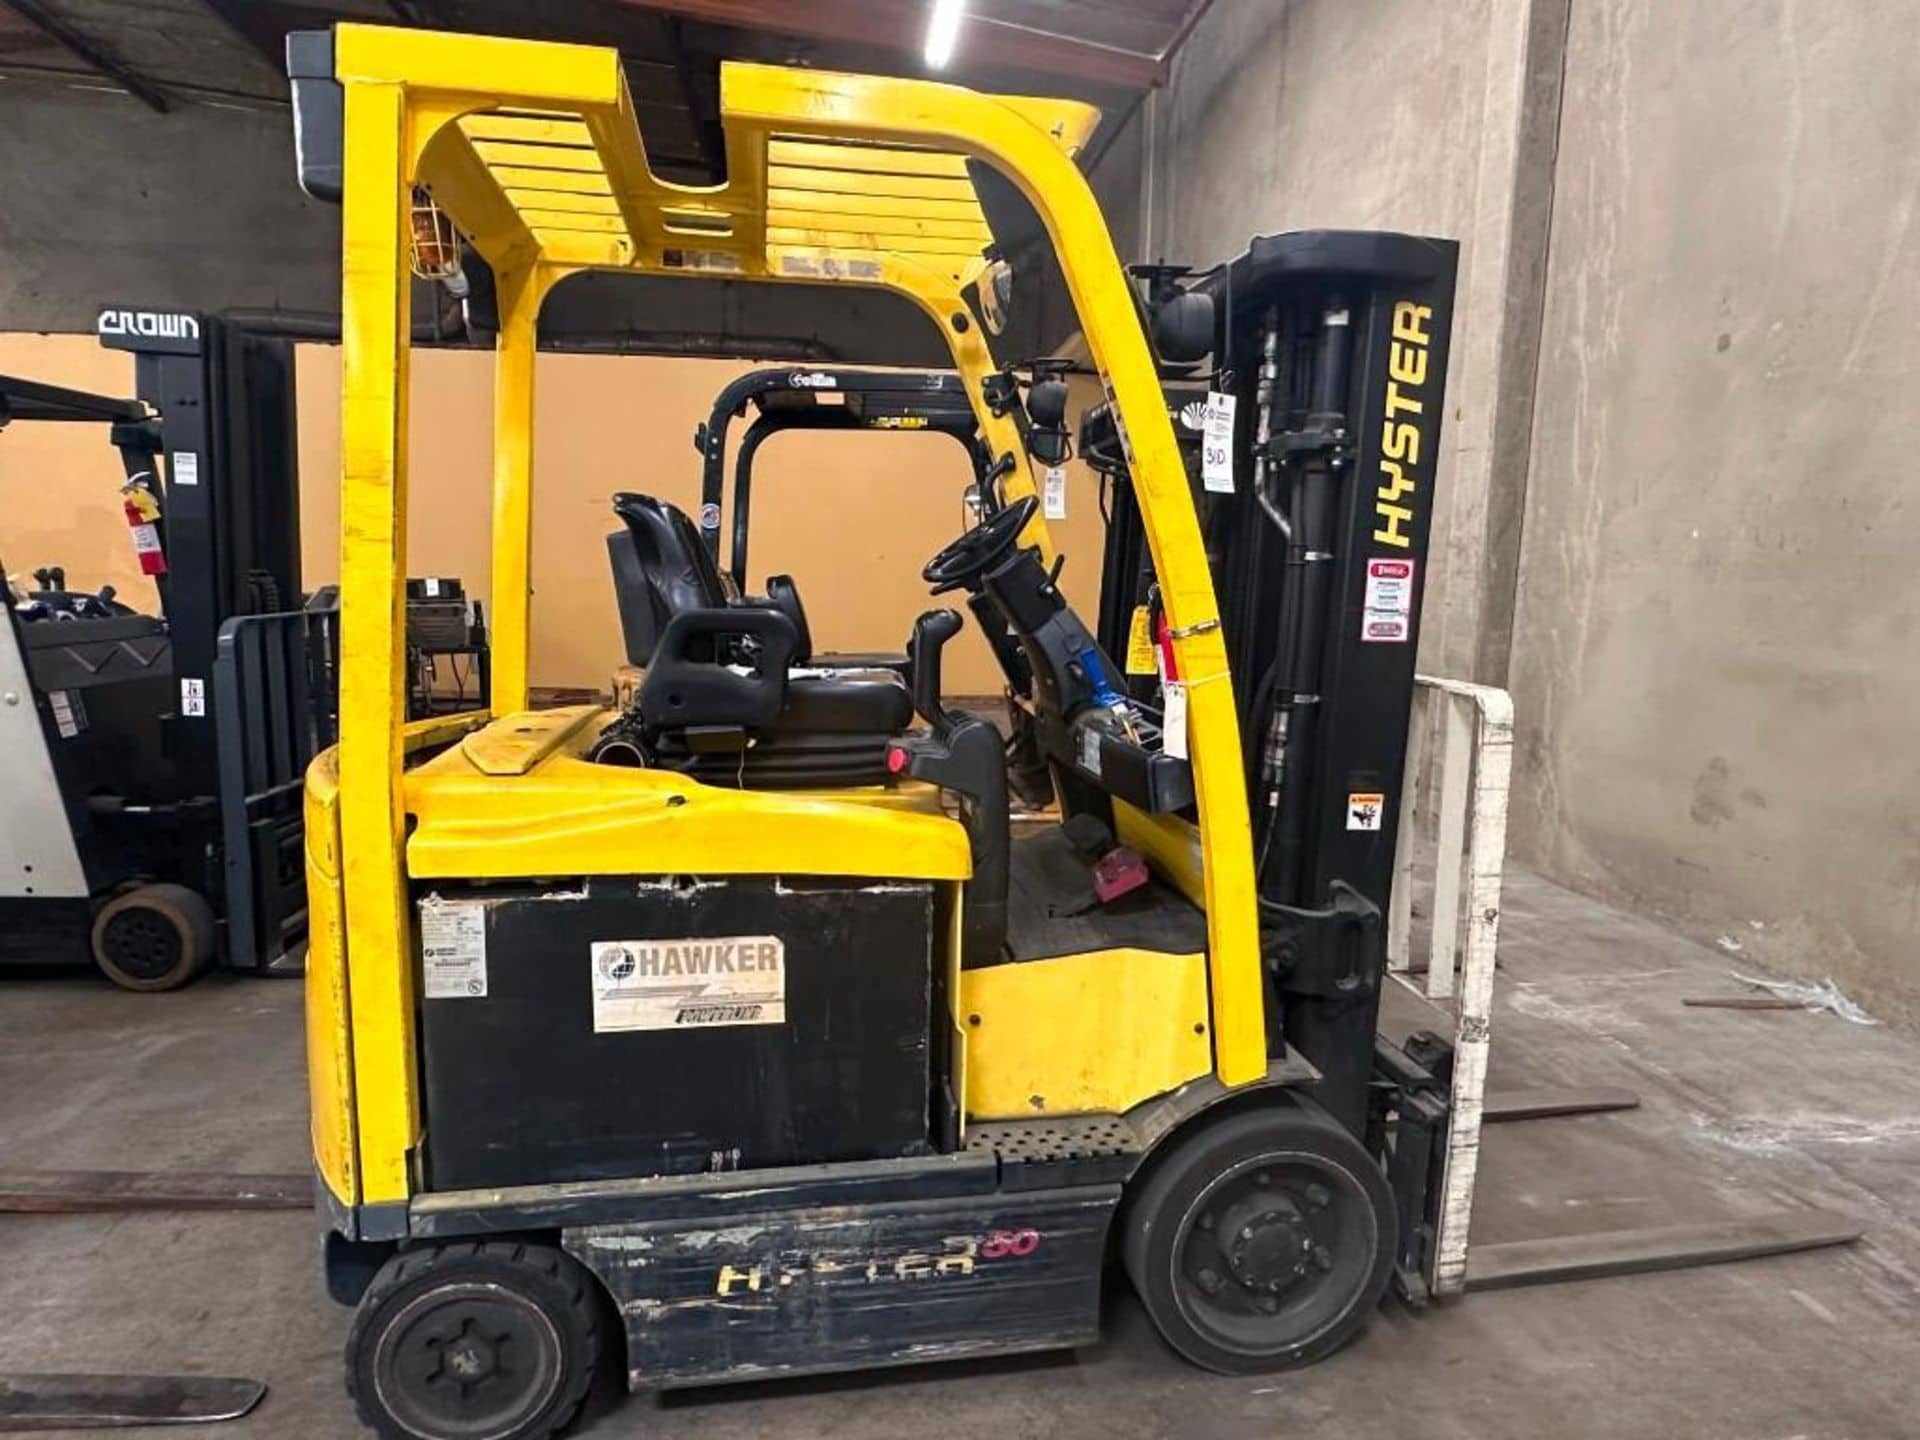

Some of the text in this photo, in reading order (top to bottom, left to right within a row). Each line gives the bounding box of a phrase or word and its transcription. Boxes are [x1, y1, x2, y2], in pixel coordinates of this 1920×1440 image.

[98, 310, 199, 339] CROWN
[1373, 300, 1433, 548] HYSTER
[640, 943, 778, 977] HAWKER
